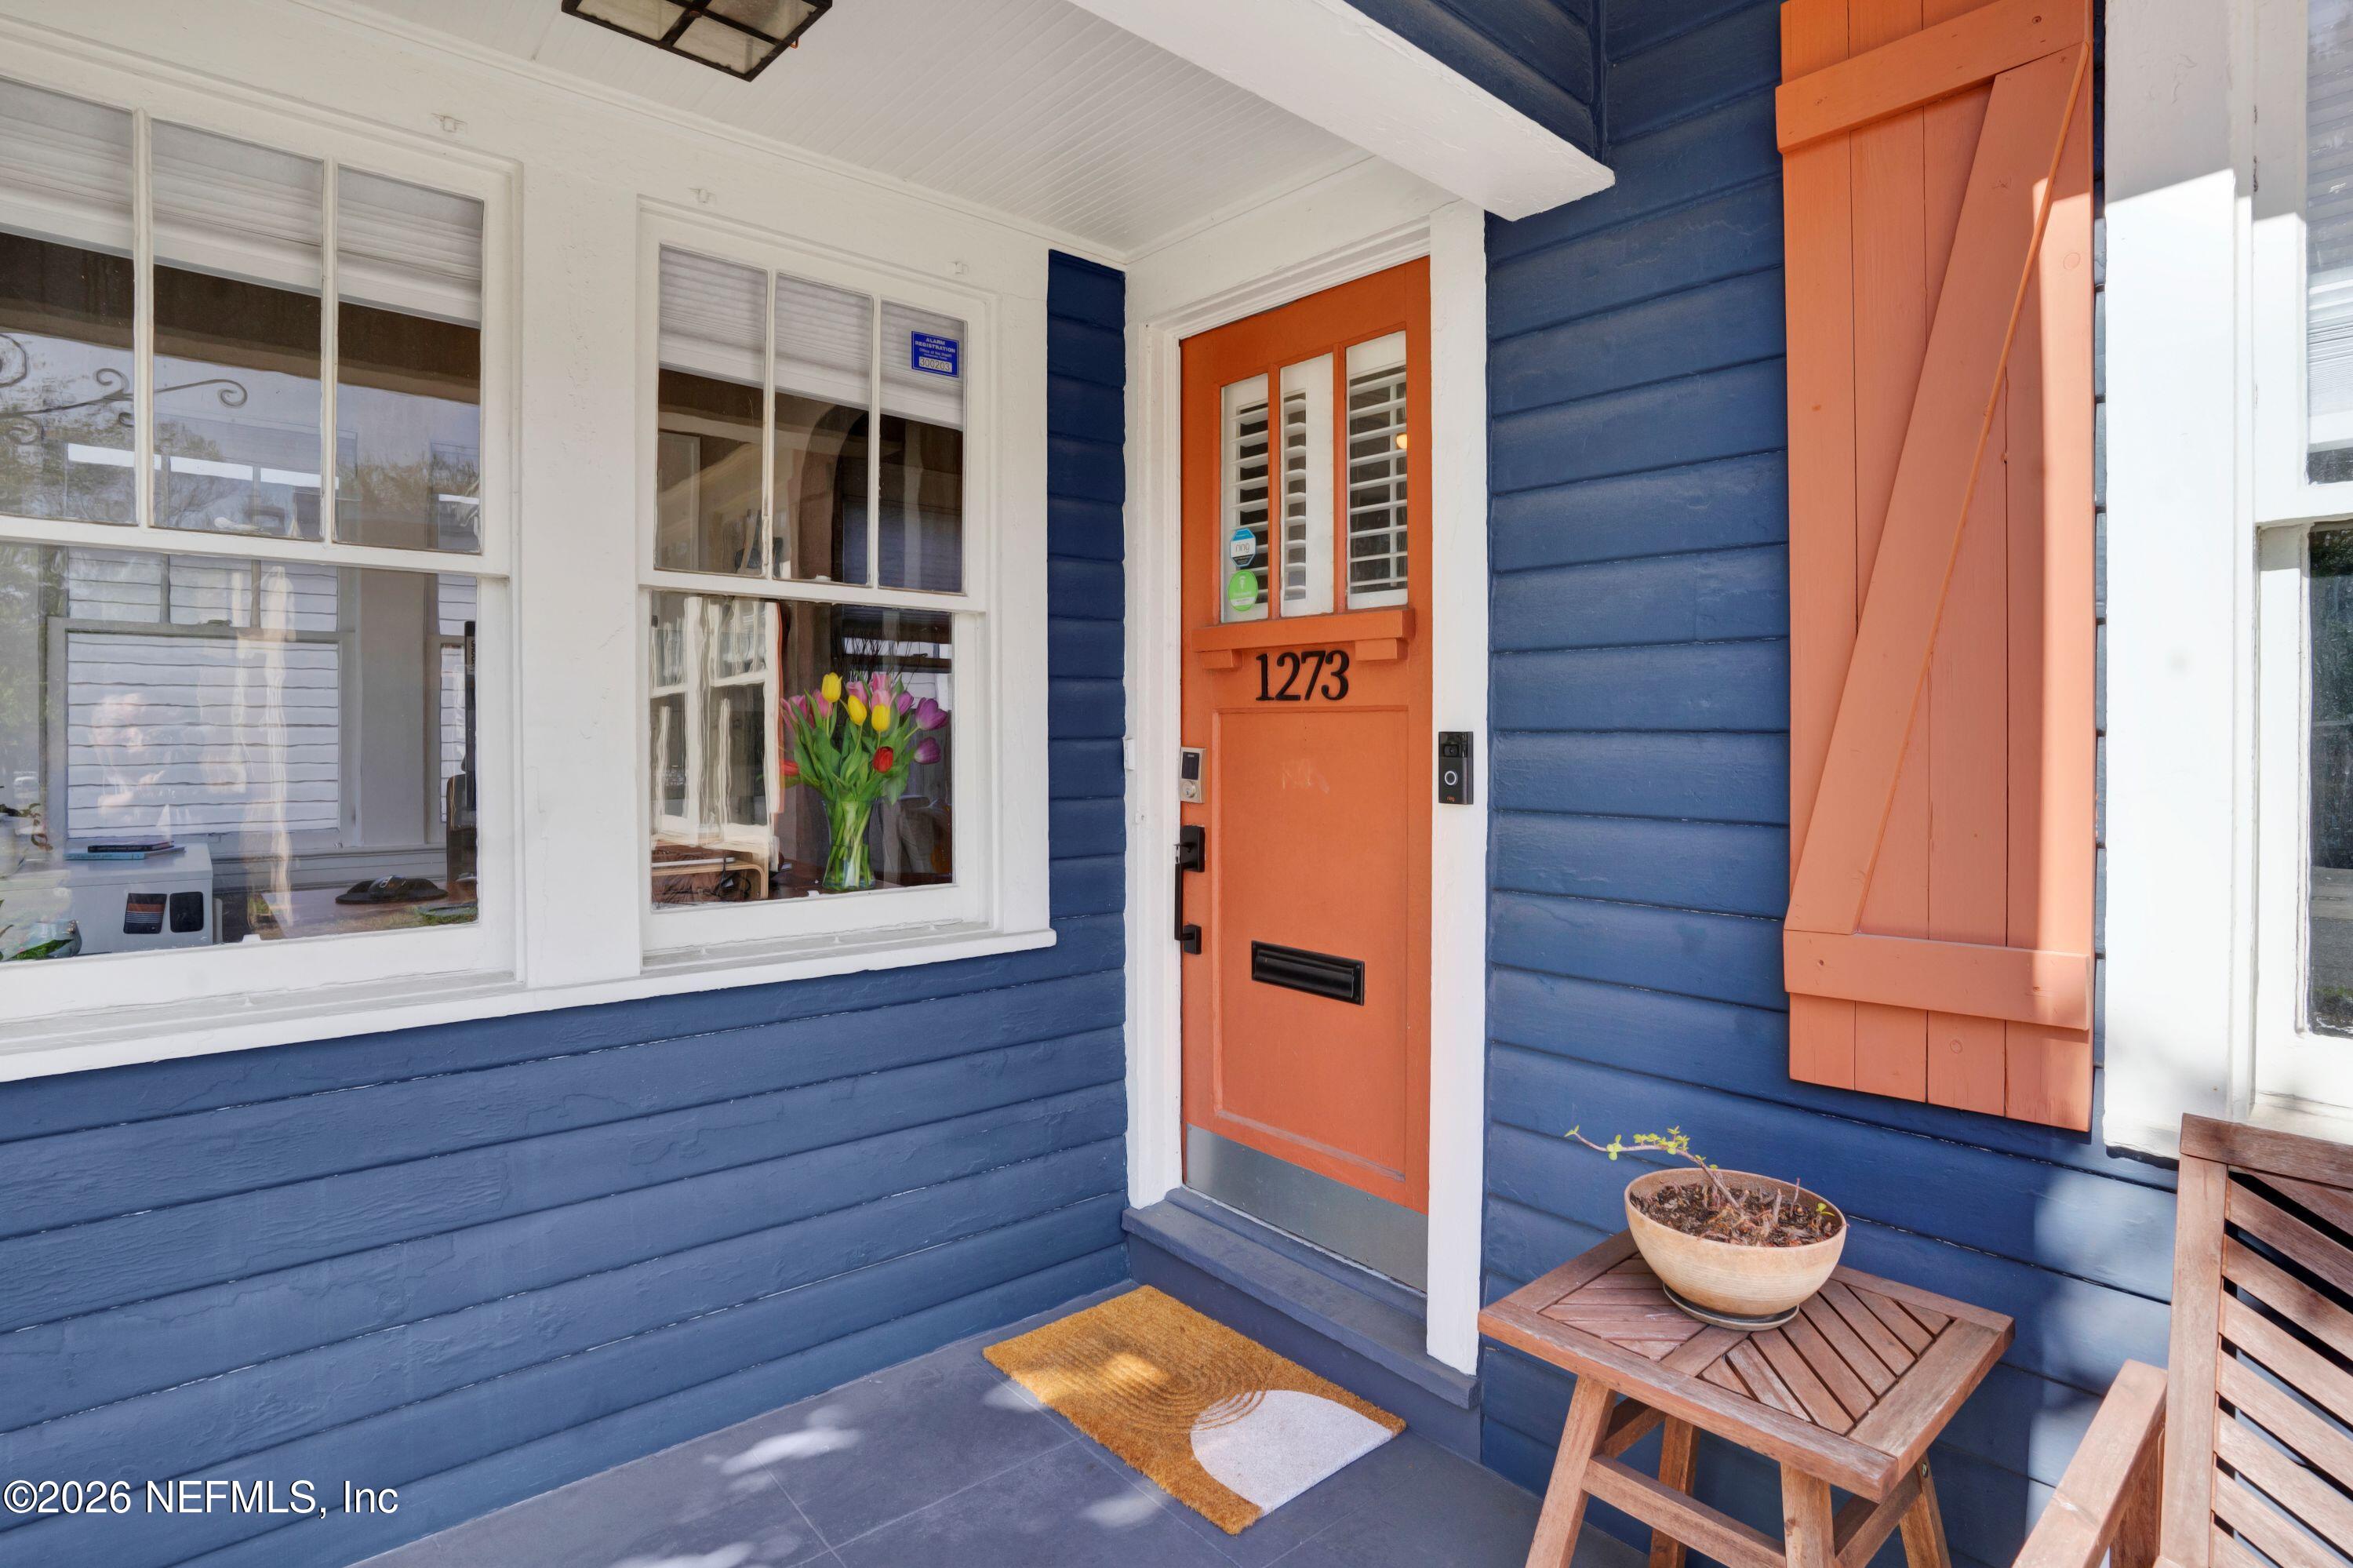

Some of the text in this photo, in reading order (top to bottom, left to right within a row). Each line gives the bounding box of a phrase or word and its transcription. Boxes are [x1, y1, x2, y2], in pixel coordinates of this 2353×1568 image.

[915, 340, 956, 353] REGISTRATION
[926, 337, 946, 346] ALARM
[1235, 542, 1250, 554] ring
[1255, 649, 1350, 701] 1273
